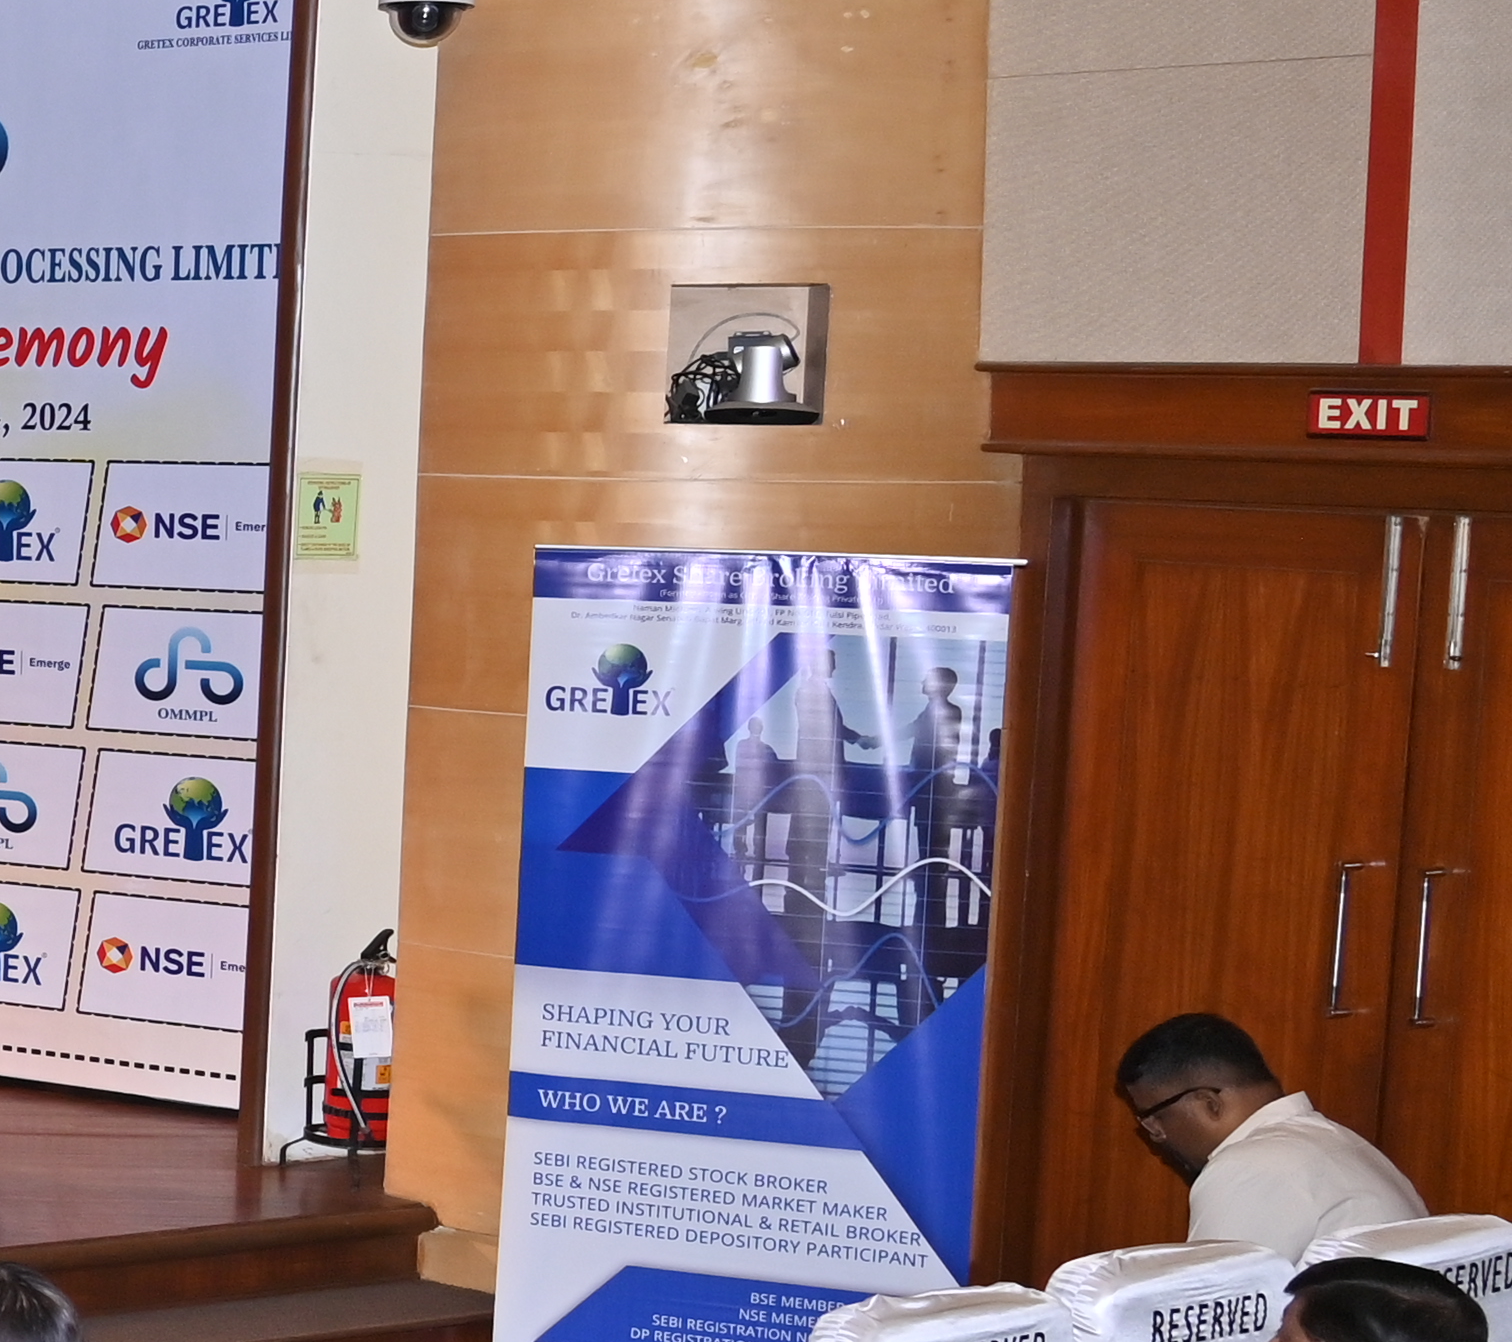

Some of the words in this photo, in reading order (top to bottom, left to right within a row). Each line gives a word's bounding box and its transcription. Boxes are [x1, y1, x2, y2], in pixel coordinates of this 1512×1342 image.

[176, 0, 278, 29] GRETEX
[138, 39, 174, 49] GRETEX
[176, 35, 232, 47] CORPORATE
[234, 32, 278, 44] SERVICES
[171, 243, 281, 282] LIMIT
[21, 403, 91, 430] 2024
[1319, 399, 1418, 430] EXIT
[155, 513, 220, 540] NSE
[158, 708, 217, 722] OMMPL
[545, 686, 670, 716] GRETEX
[140, 946, 204, 977] NSE
[543, 1004, 653, 1028] SHAPING
[660, 1013, 729, 1036] YOUR
[541, 1030, 677, 1058] FINANCIAL
[684, 1041, 789, 1069] FUTURE
[538, 1089, 600, 1111] WHO
[607, 1095, 648, 1116] WE
[654, 1101, 707, 1122] ARE
[715, 1106, 726, 1124] ?
[534, 1152, 569, 1167] SEBI
[577, 1156, 682, 1178] REGISTERED
[689, 1167, 747, 1185] STOCK
[755, 1174, 827, 1194] BROKER
[534, 1172, 564, 1187] BSE
[570, 1176, 581, 1188] &
[589, 1177, 621, 1193] NSE
[627, 1181, 736, 1205] REGISTERED
[742, 1193, 817, 1213] MARKET
[823, 1202, 887, 1221] MAKER
[532, 1192, 609, 1212] TRUSTED
[616, 1199, 752, 1228] INSTITUTIONAL
[759, 1216, 771, 1230] &
[779, 1218, 839, 1237] RETAIL
[847, 1225, 921, 1247] BROKER
[531, 1212, 566, 1228] SEBI
[572, 1216, 679, 1240] REGISTERED
[685, 1226, 800, 1254] DEPOSITORY
[807, 1242, 928, 1268] PARTICIPANT
[751, 1293, 776, 1305] BSE
[652, 1315, 682, 1328] SEBI
[687, 1319, 791, 1341] REGISTRATION
[739, 1309, 766, 1322] NSE
[631, 1328, 649, 1339] DP
